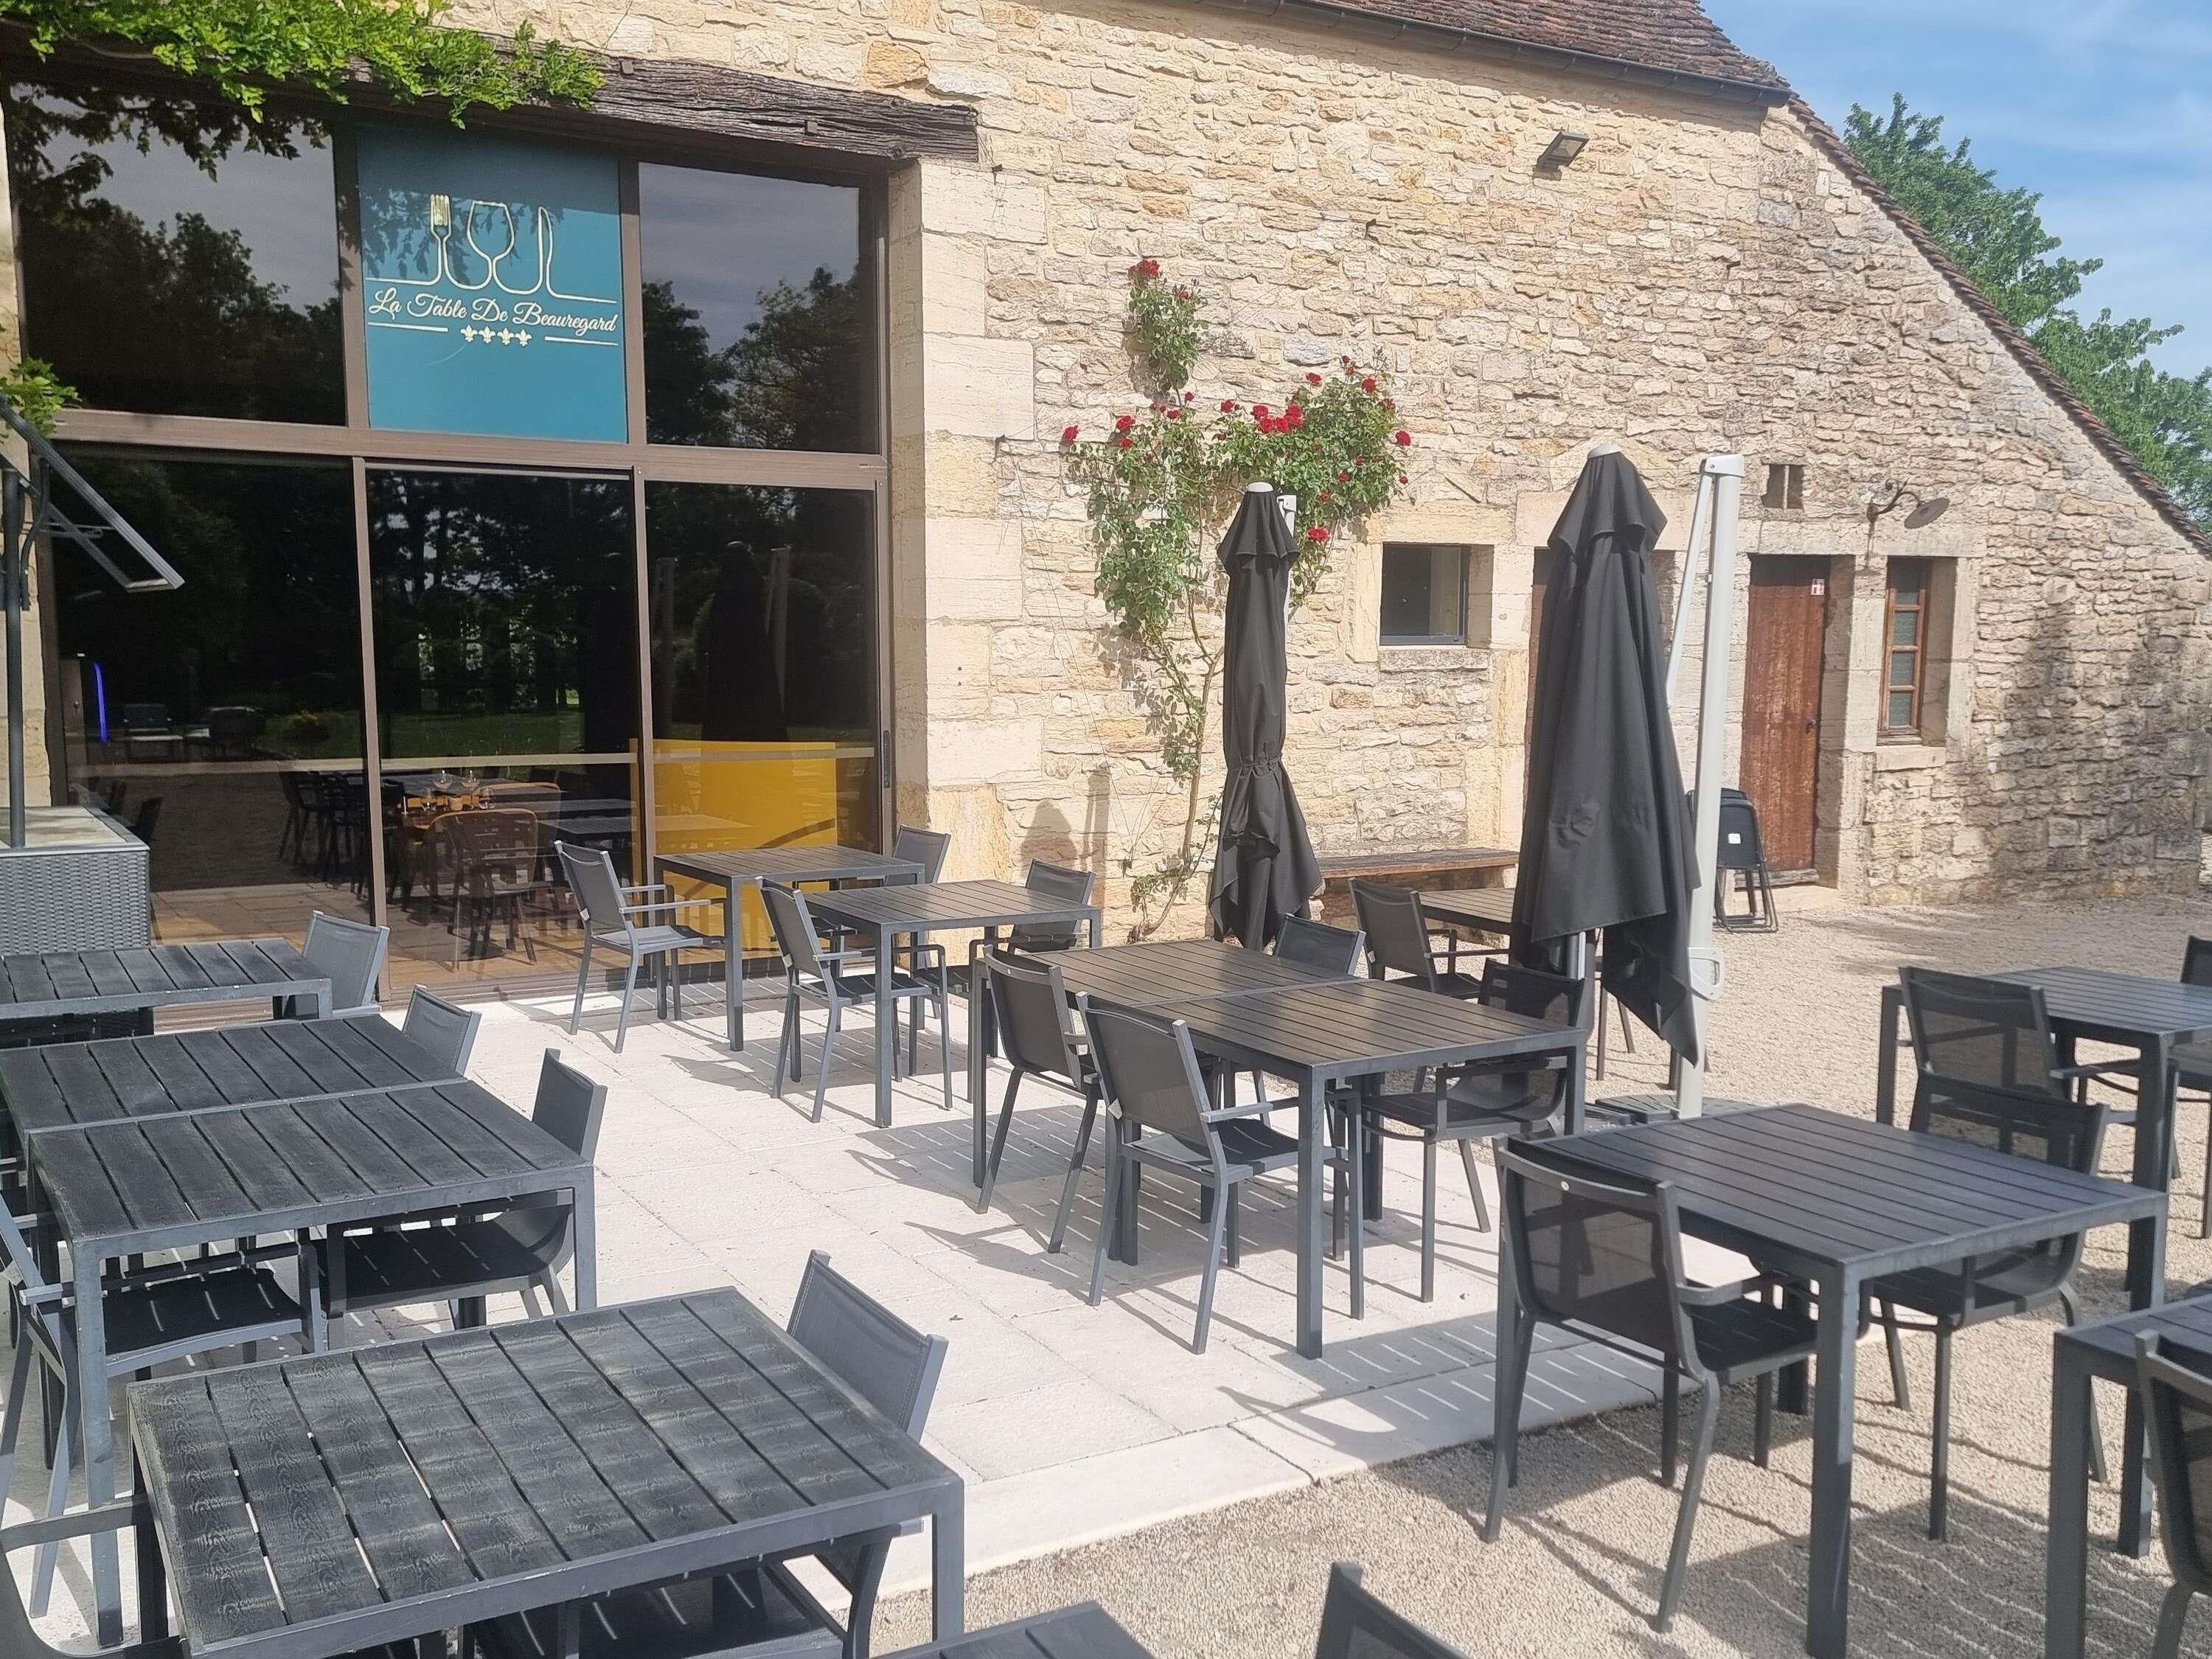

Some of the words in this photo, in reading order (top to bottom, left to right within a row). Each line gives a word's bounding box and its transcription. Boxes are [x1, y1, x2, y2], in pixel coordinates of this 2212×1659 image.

[369, 288, 402, 320] La
[407, 293, 467, 319] Table
[470, 298, 508, 321] De
[512, 302, 616, 336] Beauregard
